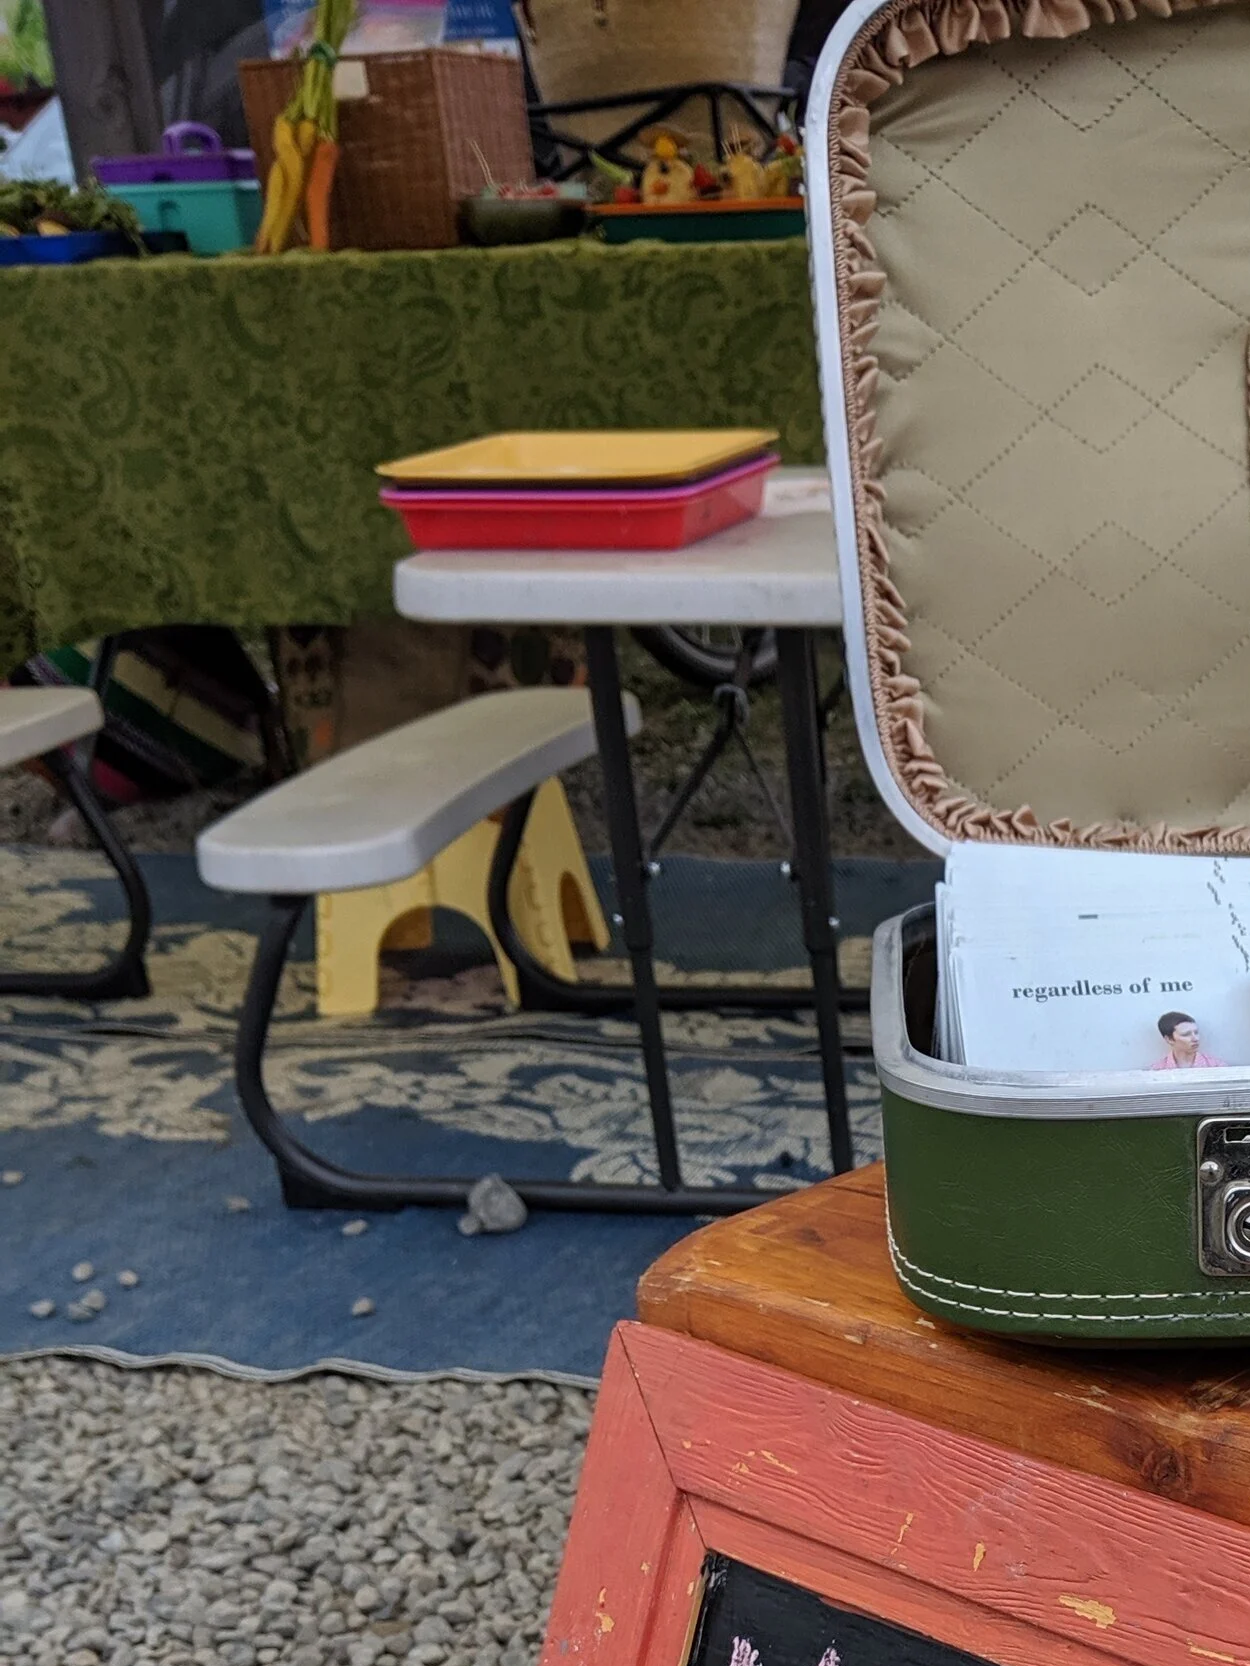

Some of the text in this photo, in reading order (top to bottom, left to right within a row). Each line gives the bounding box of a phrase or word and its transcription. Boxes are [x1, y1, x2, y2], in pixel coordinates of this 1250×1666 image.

[1012, 977, 1194, 1003] regardless of me
